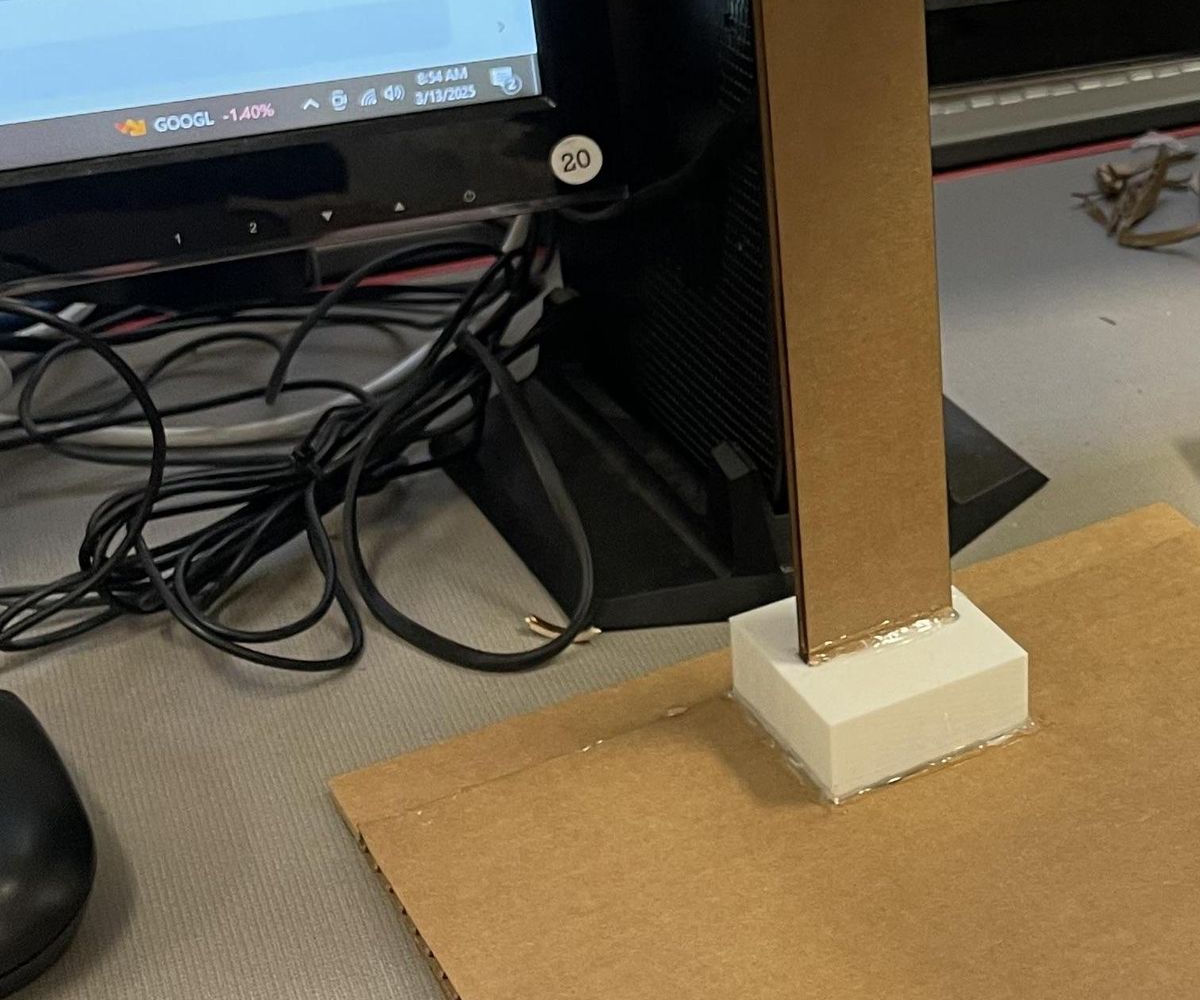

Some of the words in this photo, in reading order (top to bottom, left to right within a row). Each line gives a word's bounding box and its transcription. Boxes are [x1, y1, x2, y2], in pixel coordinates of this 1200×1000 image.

[444, 65, 469, 82] AM
[154, 110, 215, 133] GOOGL
[221, 102, 275, 123] -1.40%
[561, 148, 592, 173] 20
[249, 221, 258, 234] 2
